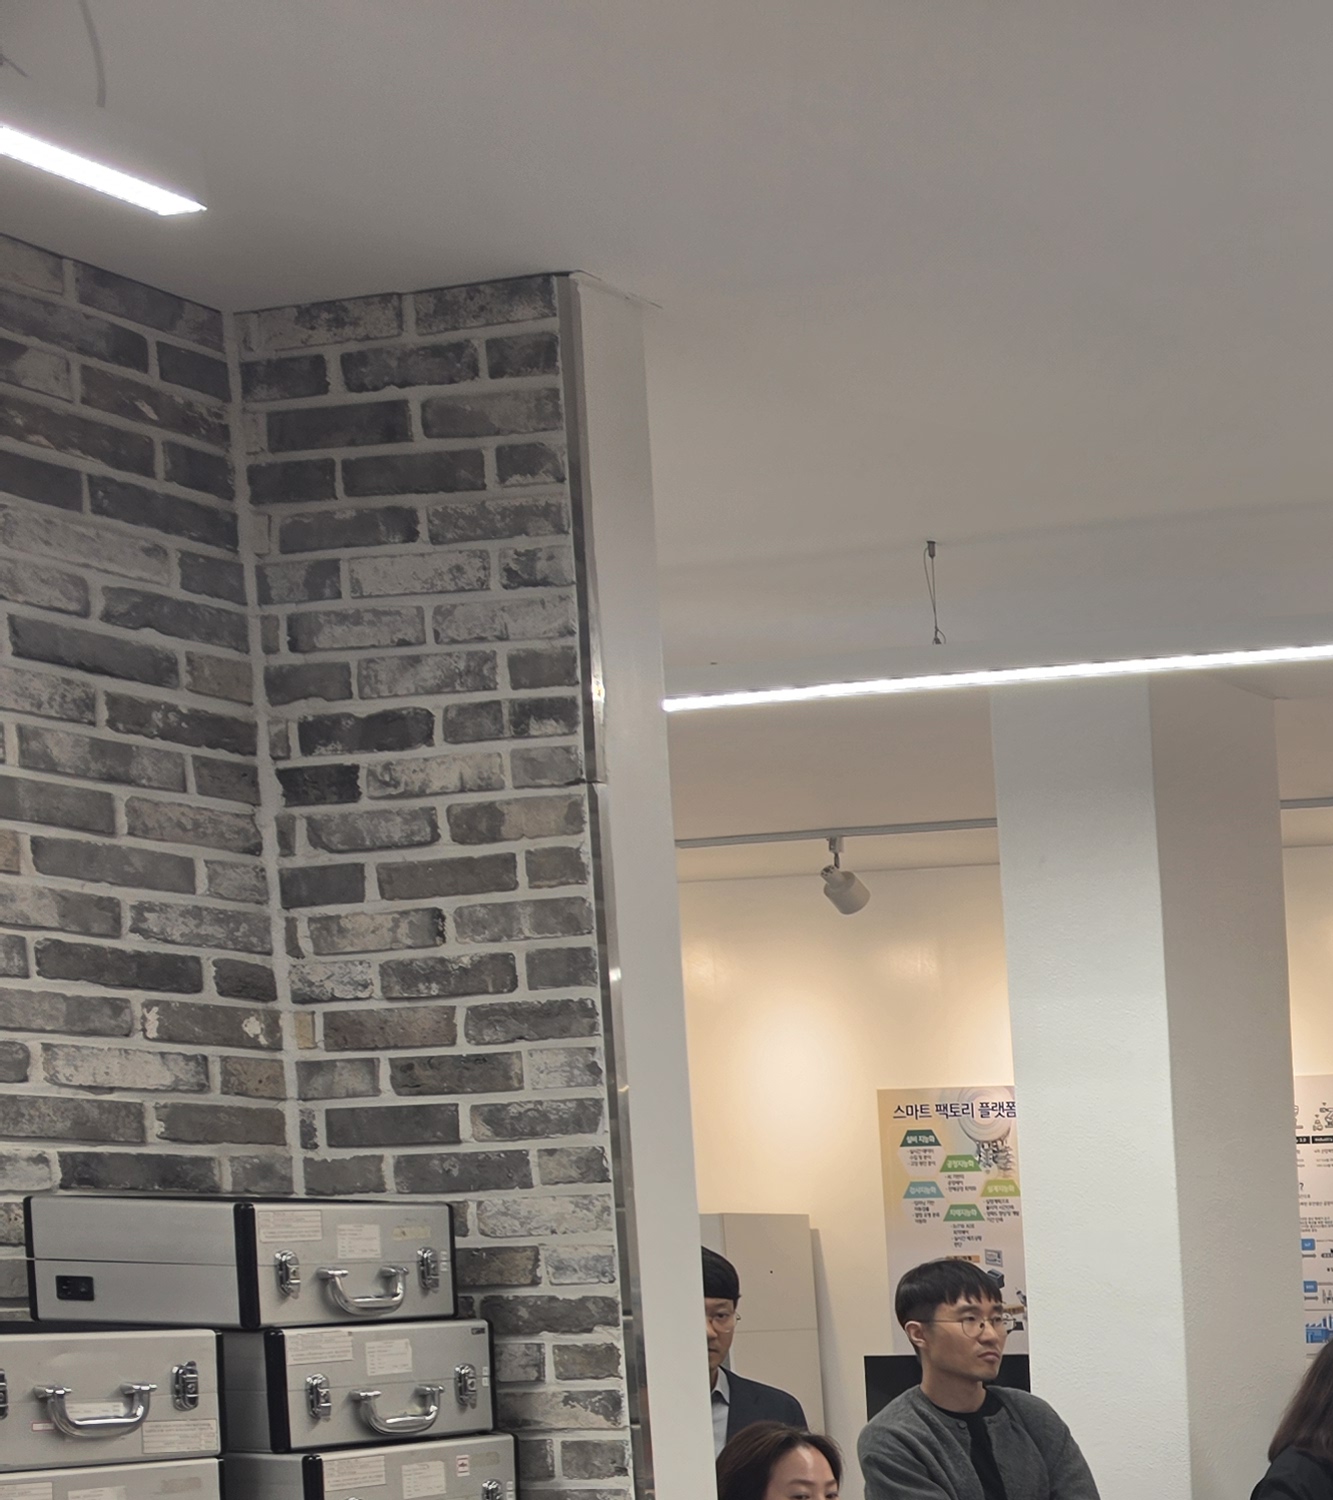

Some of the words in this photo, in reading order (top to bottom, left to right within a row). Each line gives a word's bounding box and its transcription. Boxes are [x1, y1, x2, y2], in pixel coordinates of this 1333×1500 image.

[893, 1104, 932, 1120] 스마트
[935, 1103, 974, 1119] 팩토리
[978, 1101, 1016, 1119] 플랫폼
